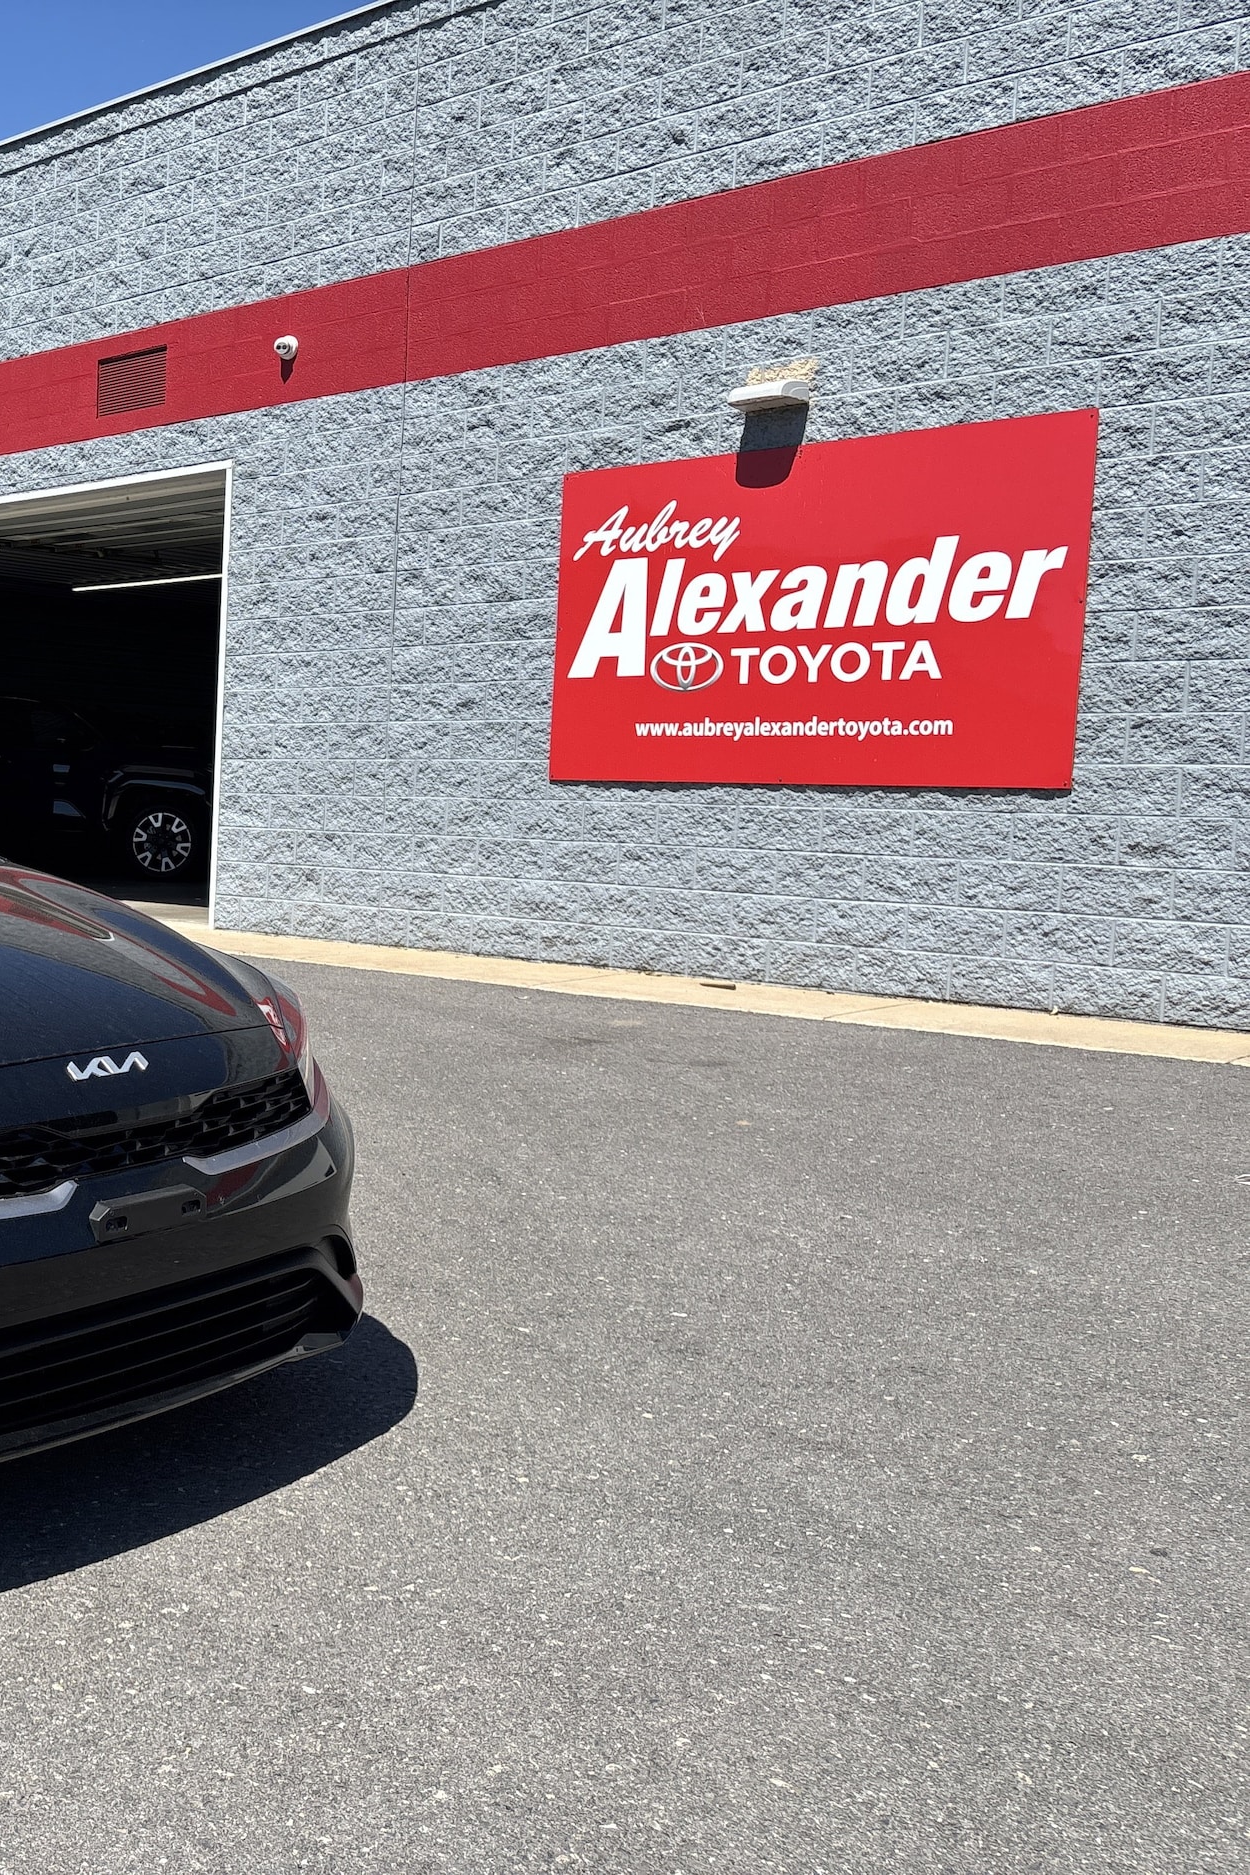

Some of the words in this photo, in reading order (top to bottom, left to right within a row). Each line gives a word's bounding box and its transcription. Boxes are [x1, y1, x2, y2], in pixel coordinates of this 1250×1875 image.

[573, 500, 741, 562] Aubrey
[568, 535, 1068, 679] Alexander
[731, 640, 942, 685] TOYOTA
[635, 715, 955, 742] www.aubreyalexandertoyota.com
[66, 1051, 149, 1081] KIA
